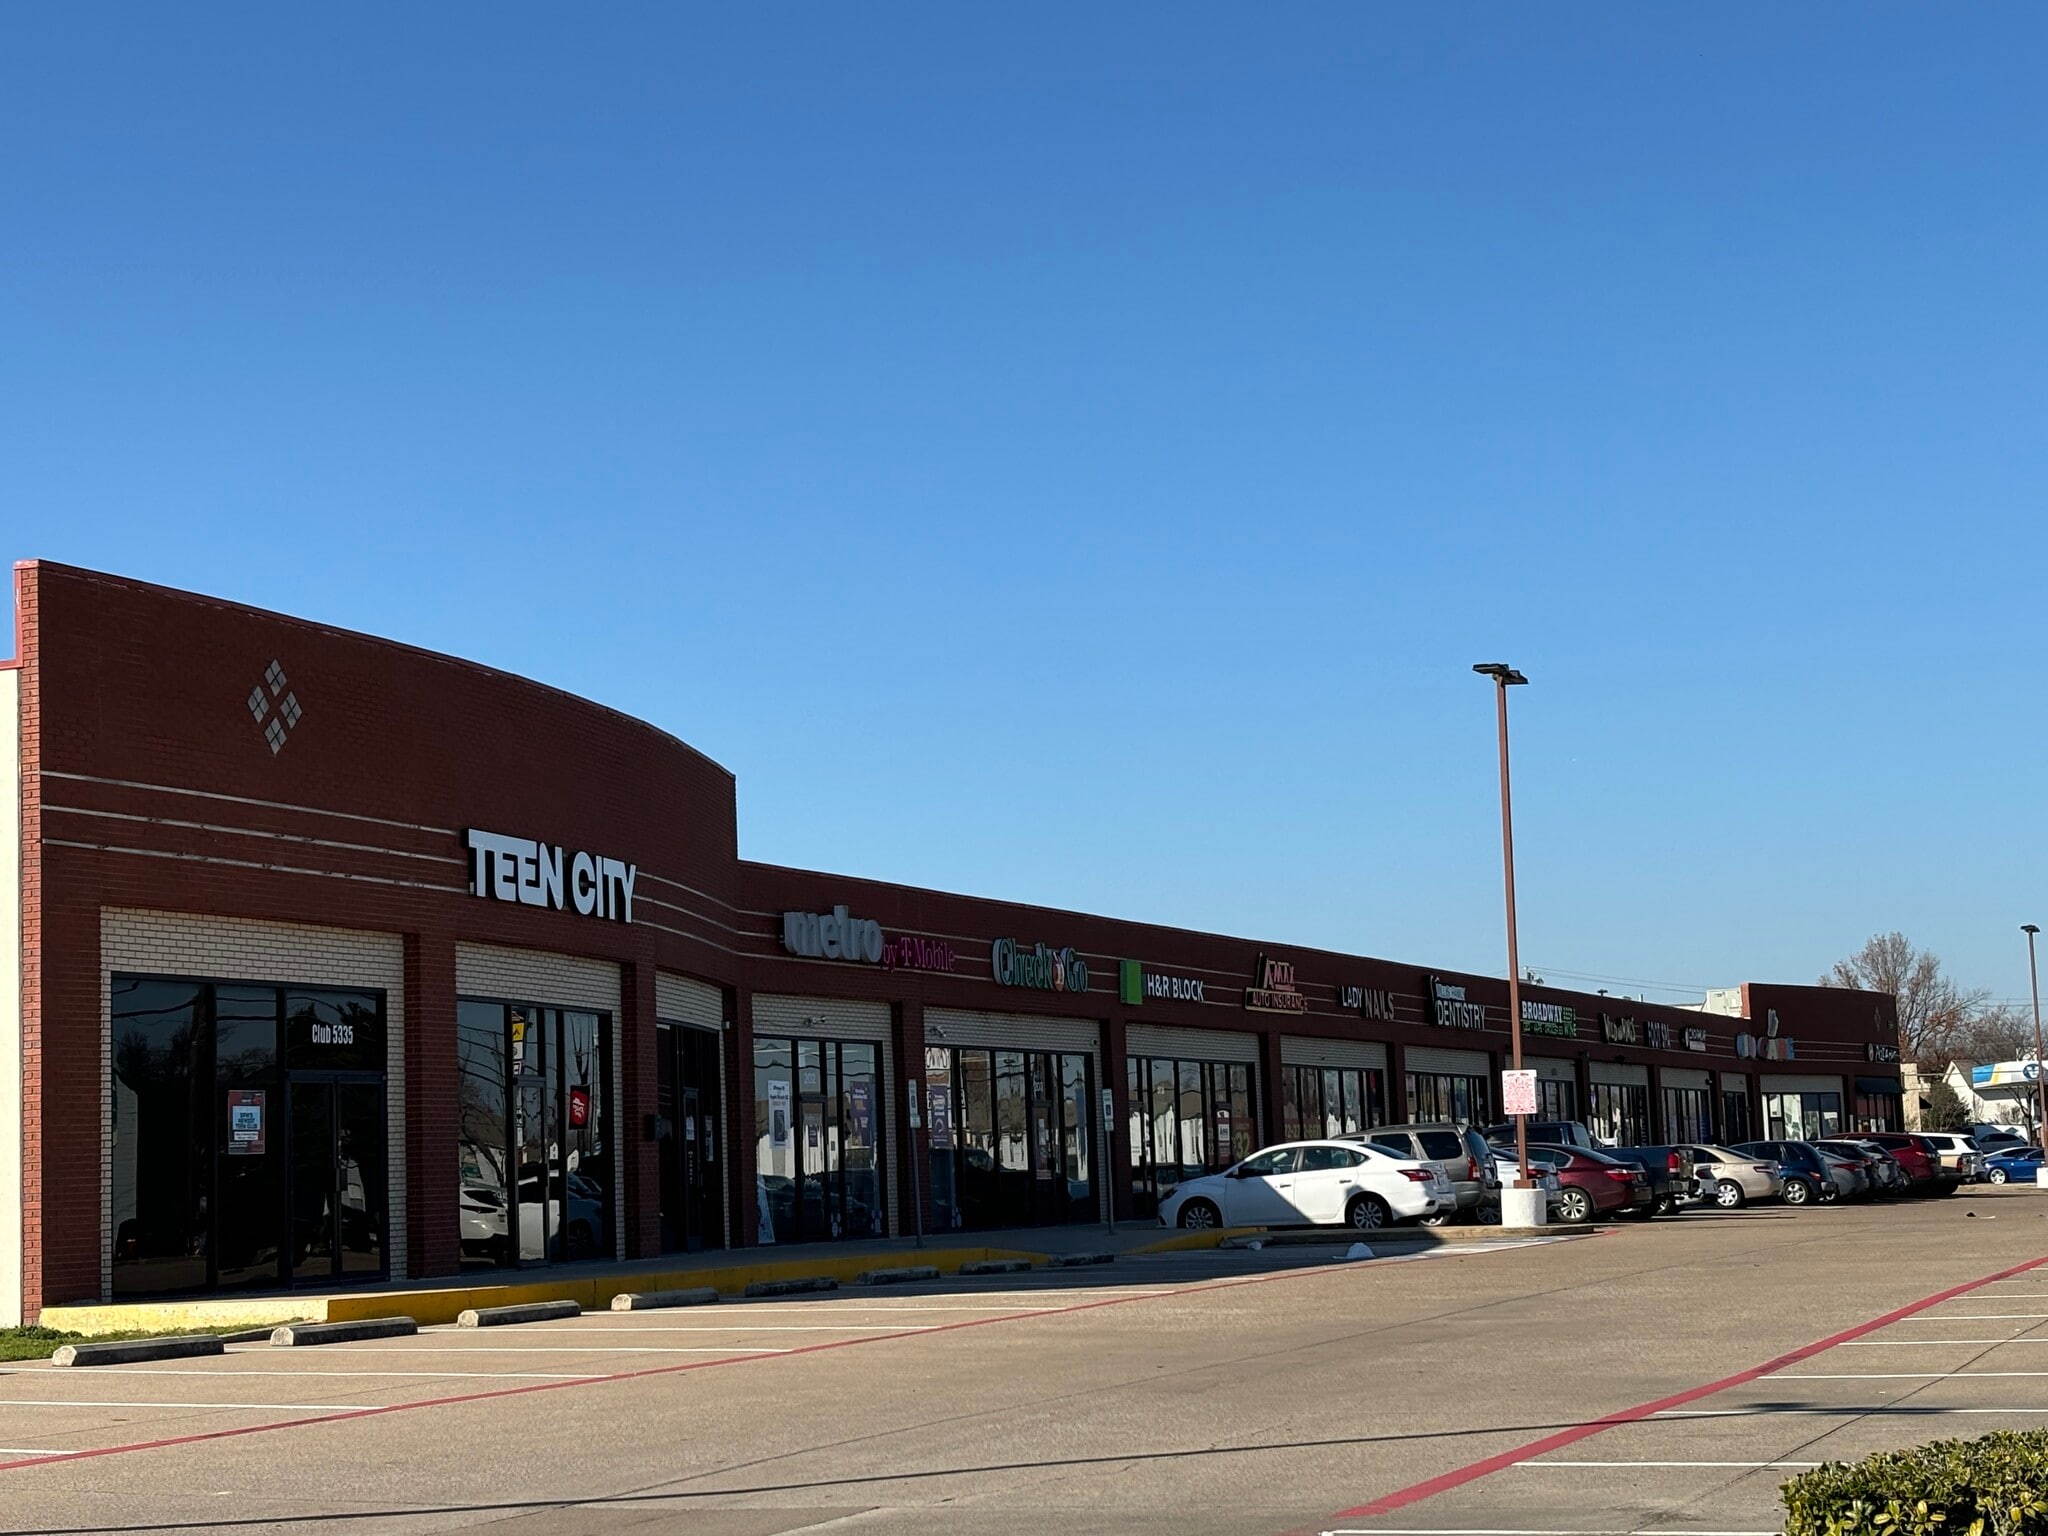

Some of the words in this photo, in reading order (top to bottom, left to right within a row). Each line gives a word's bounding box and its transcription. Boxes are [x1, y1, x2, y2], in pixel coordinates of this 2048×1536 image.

[468, 828, 563, 911] TEEN
[571, 851, 637, 924] CITY
[783, 904, 883, 964] metro
[992, 937, 1054, 989] Check
[1060, 946, 1089, 993] Go
[1146, 973, 1170, 998] H&R
[1172, 977, 1205, 1004] BLOCK
[1252, 991, 1270, 1008] AUTO
[1271, 994, 1308, 1012] INSURANCE
[1340, 985, 1363, 1009] LADY
[1364, 987, 1395, 1021] NAILS
[1436, 999, 1487, 1030] DENTISTRY
[1521, 1000, 1563, 1024] BROADWAY
[312, 1023, 331, 1044] Club
[332, 1024, 354, 1045] 5335
